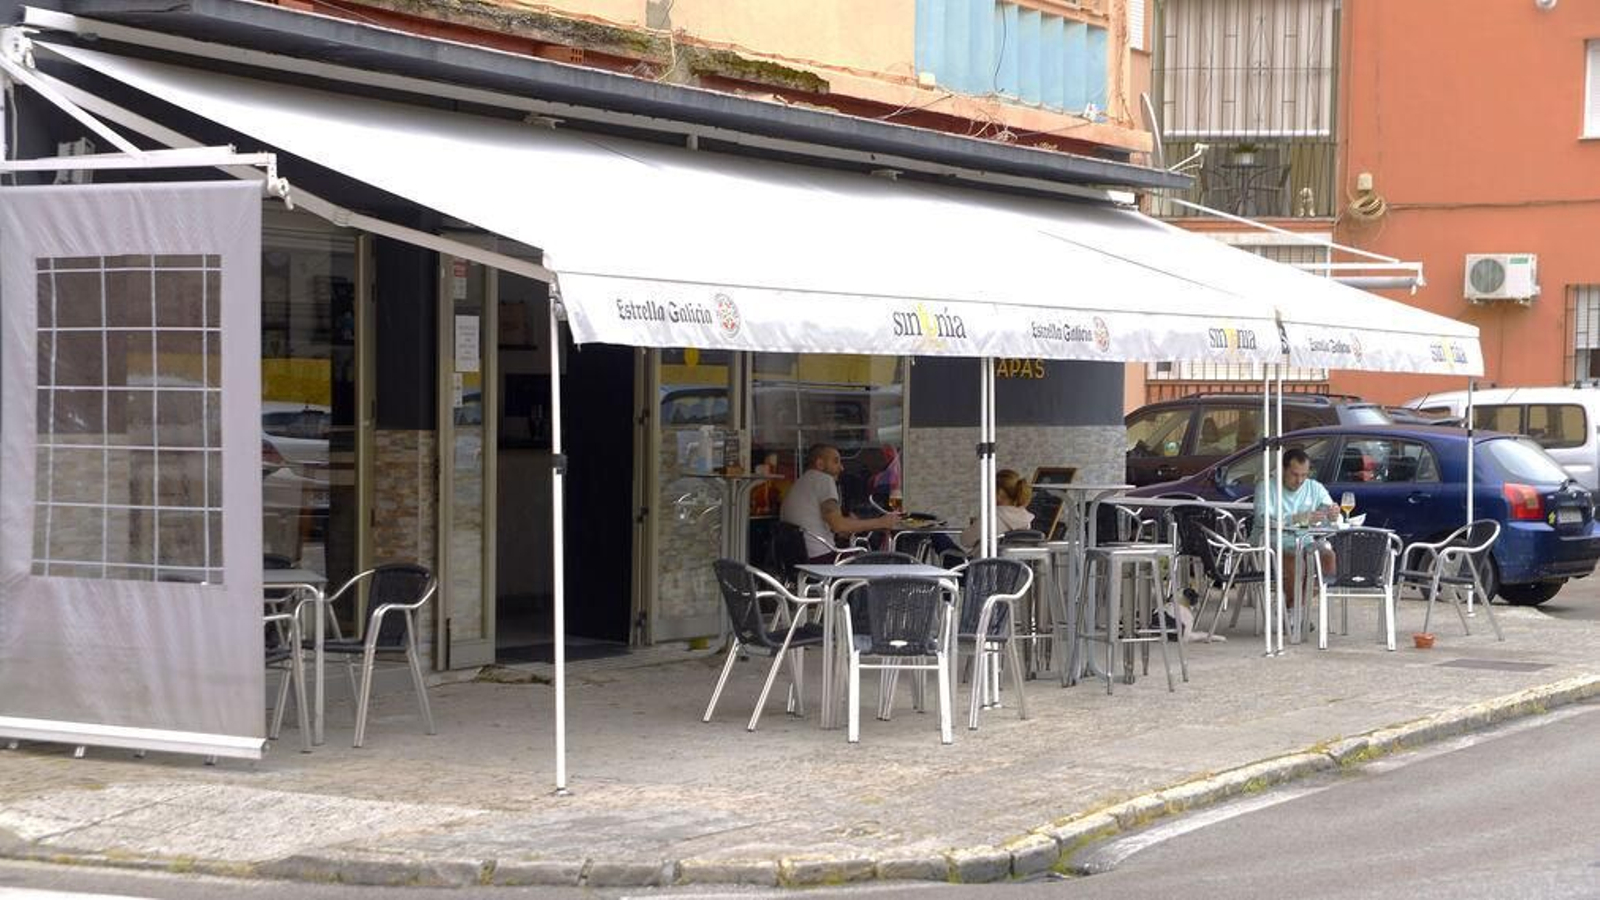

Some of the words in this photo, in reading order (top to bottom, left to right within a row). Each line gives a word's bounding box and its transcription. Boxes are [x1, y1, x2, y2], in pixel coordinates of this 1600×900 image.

[616, 299, 666, 321] Estrella
[668, 301, 713, 324] Galicia
[988, 358, 1046, 379] APAS
